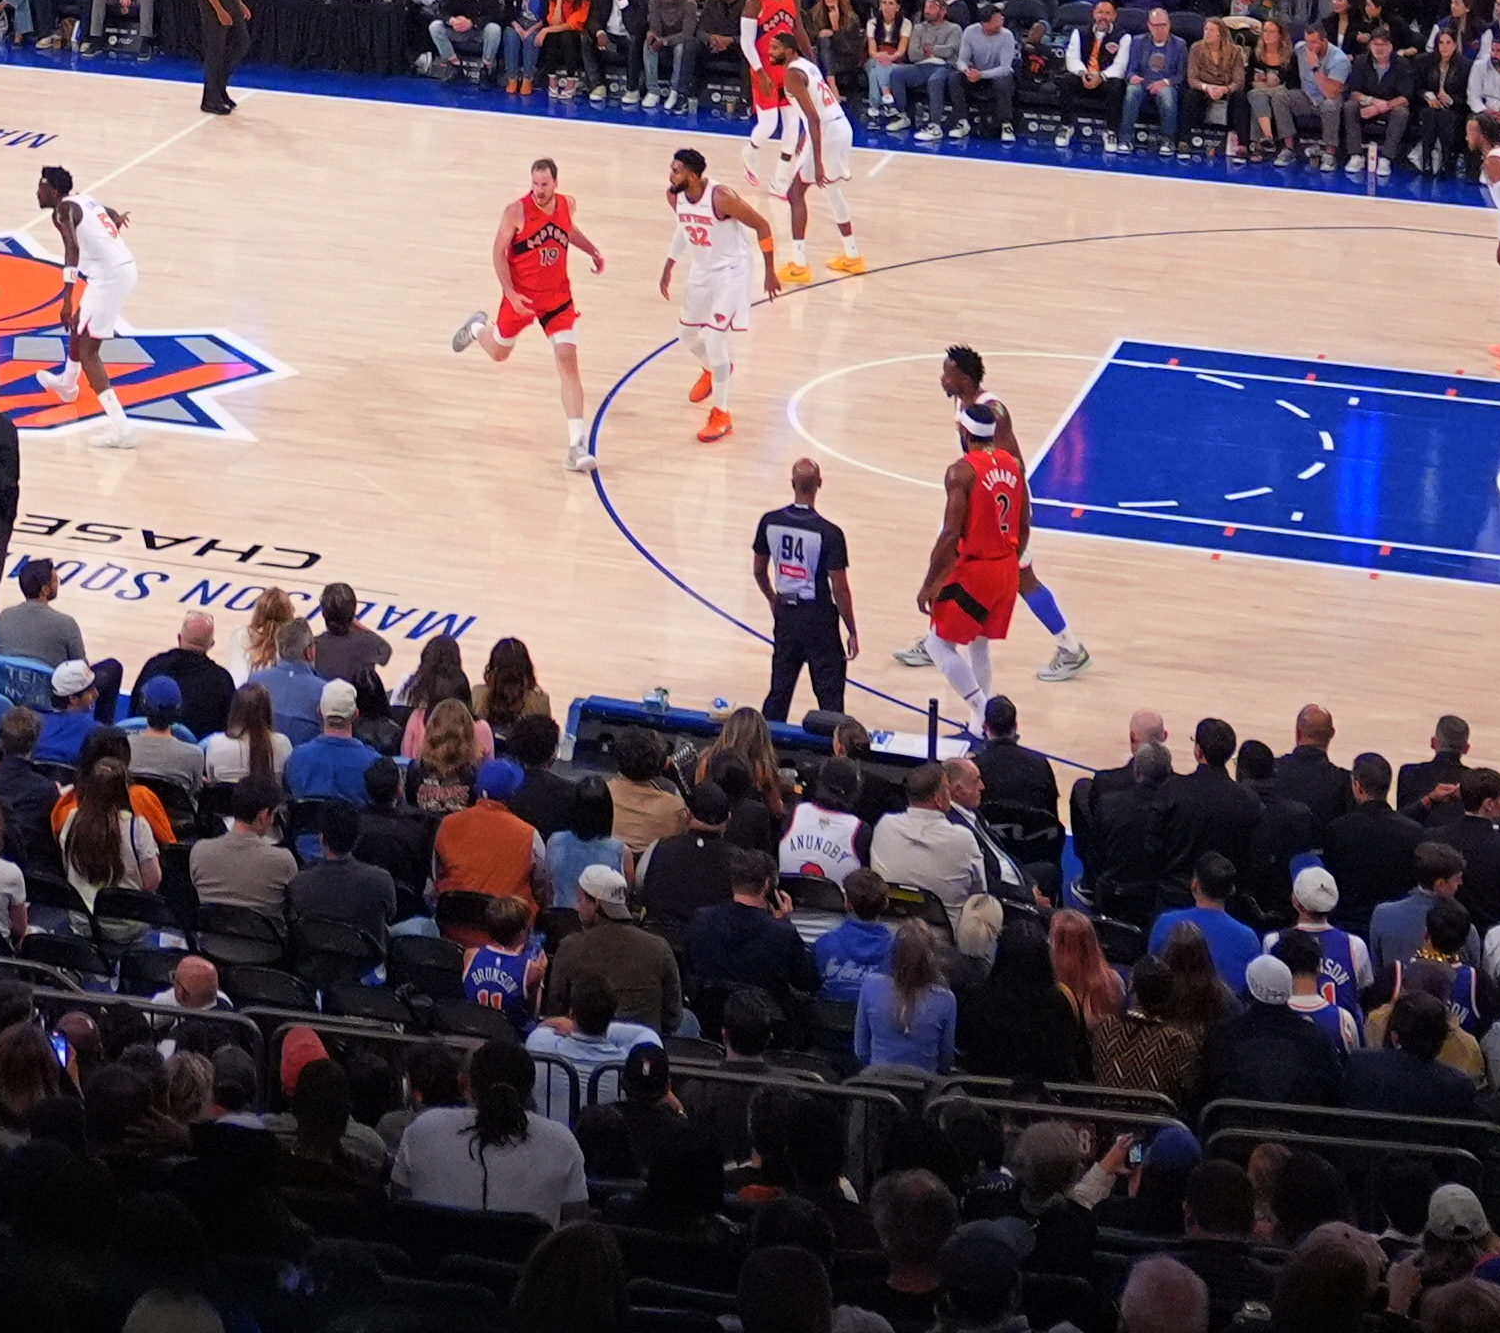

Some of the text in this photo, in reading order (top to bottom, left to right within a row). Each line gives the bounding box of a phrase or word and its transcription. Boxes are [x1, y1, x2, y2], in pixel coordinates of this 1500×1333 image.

[685, 225, 713, 247] 32
[540, 247, 559, 267] 19
[996, 492, 1011, 534] 2
[13, 511, 323, 571] CHASE
[781, 534, 805, 564] 94
[470, 966, 519, 994] BRUNSON
